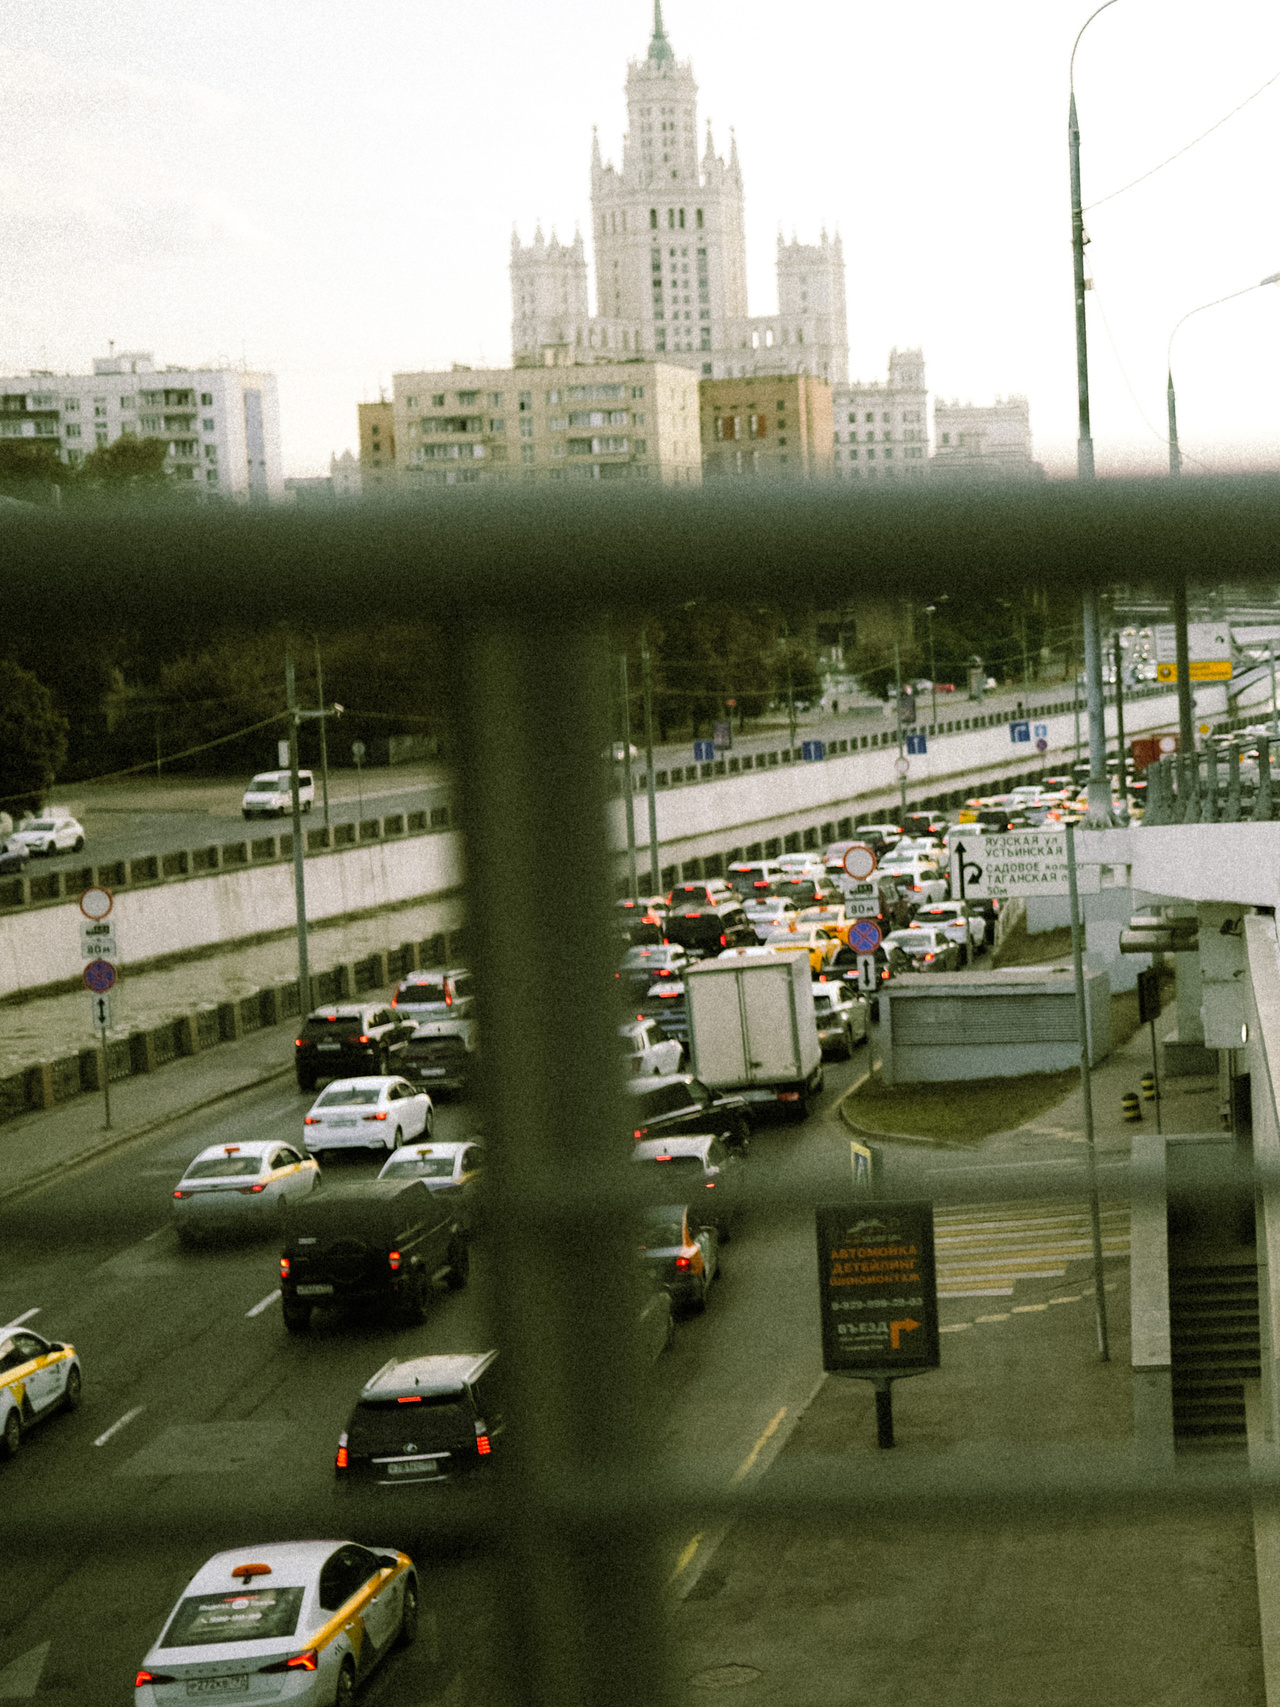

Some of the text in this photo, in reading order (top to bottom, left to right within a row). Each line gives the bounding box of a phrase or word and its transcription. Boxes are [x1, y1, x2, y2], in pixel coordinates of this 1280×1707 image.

[985, 836, 1039, 846] ЯУЗСКАЯ
[985, 846, 1063, 858] УСТЬИНСКАЯ
[986, 861, 1040, 873] САДОВОЕ
[987, 872, 1057, 884] ТАГАНСКАЯ
[987, 886, 1008, 895] 50м
[830, 1244, 918, 1259] АВТОМОЙКА
[837, 1321, 889, 1334] ВЪЕЗД
